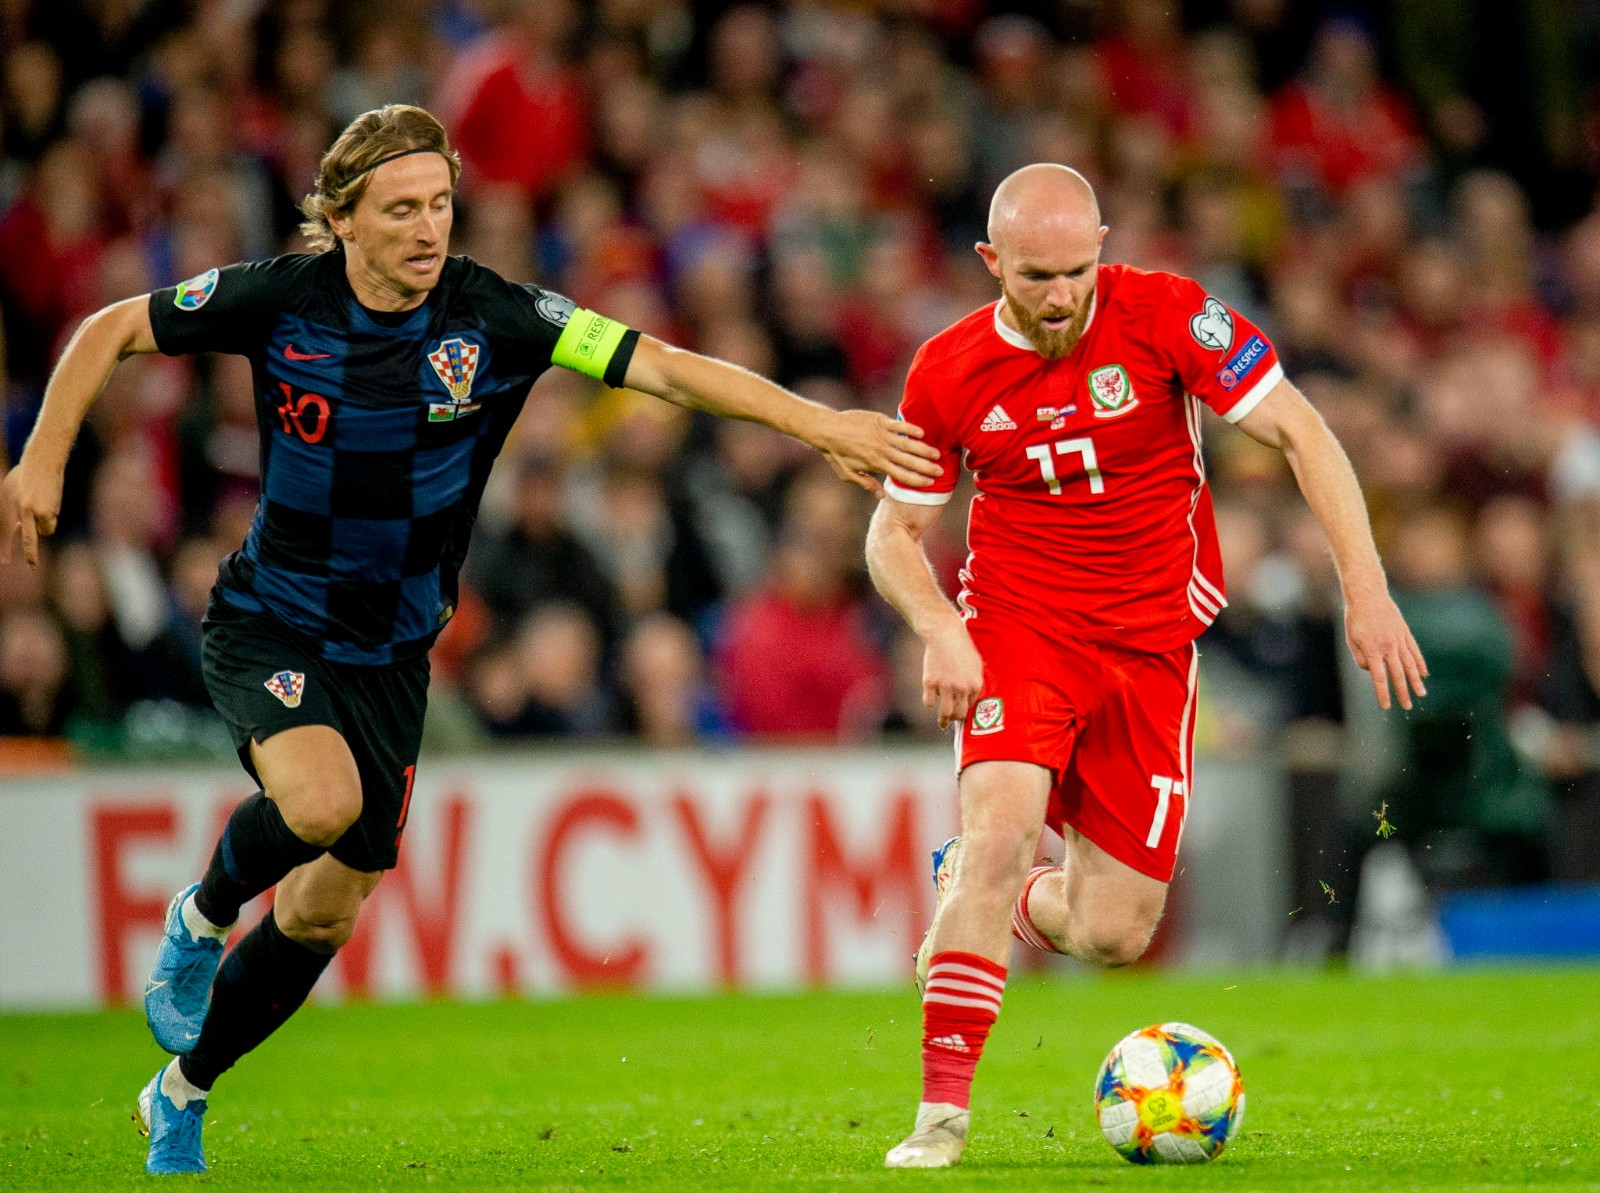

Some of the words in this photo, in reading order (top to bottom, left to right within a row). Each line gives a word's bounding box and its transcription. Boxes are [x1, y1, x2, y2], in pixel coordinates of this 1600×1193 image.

[587, 317, 606, 341] RESP
[448, 346, 461, 376] HNS
[1232, 338, 1265, 375] RESPECT
[278, 381, 330, 444] 10
[980, 421, 1018, 432] adidas
[1025, 437, 1105, 496] 17
[90, 790, 1185, 995] FW.CYM
